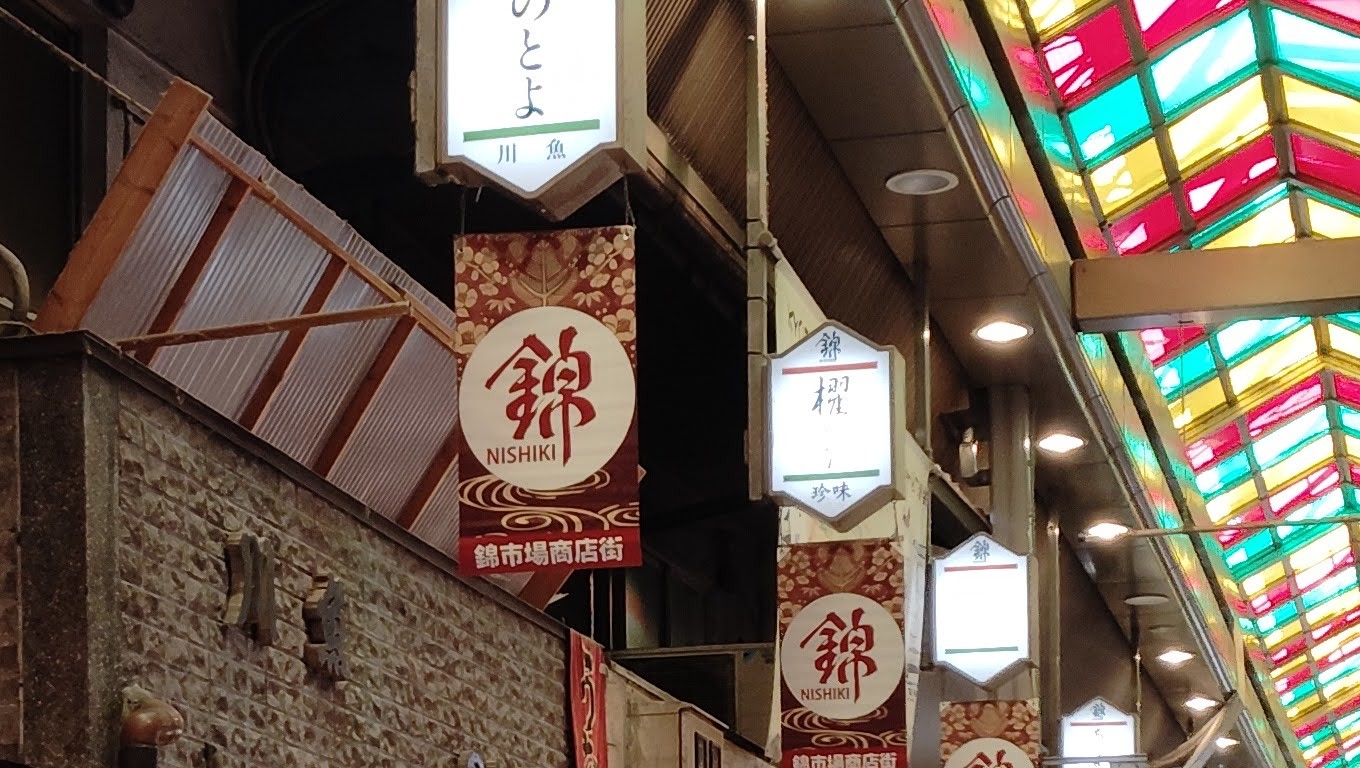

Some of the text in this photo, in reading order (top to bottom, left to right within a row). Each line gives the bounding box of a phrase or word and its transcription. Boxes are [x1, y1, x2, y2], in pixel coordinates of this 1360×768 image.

[485, 326, 596, 467] 錦
[487, 444, 556, 465] NISHIKI
[474, 537, 624, 569] 錦市場商店街
[800, 607, 878, 703] 錦
[800, 688, 850, 701] NISHIKI
